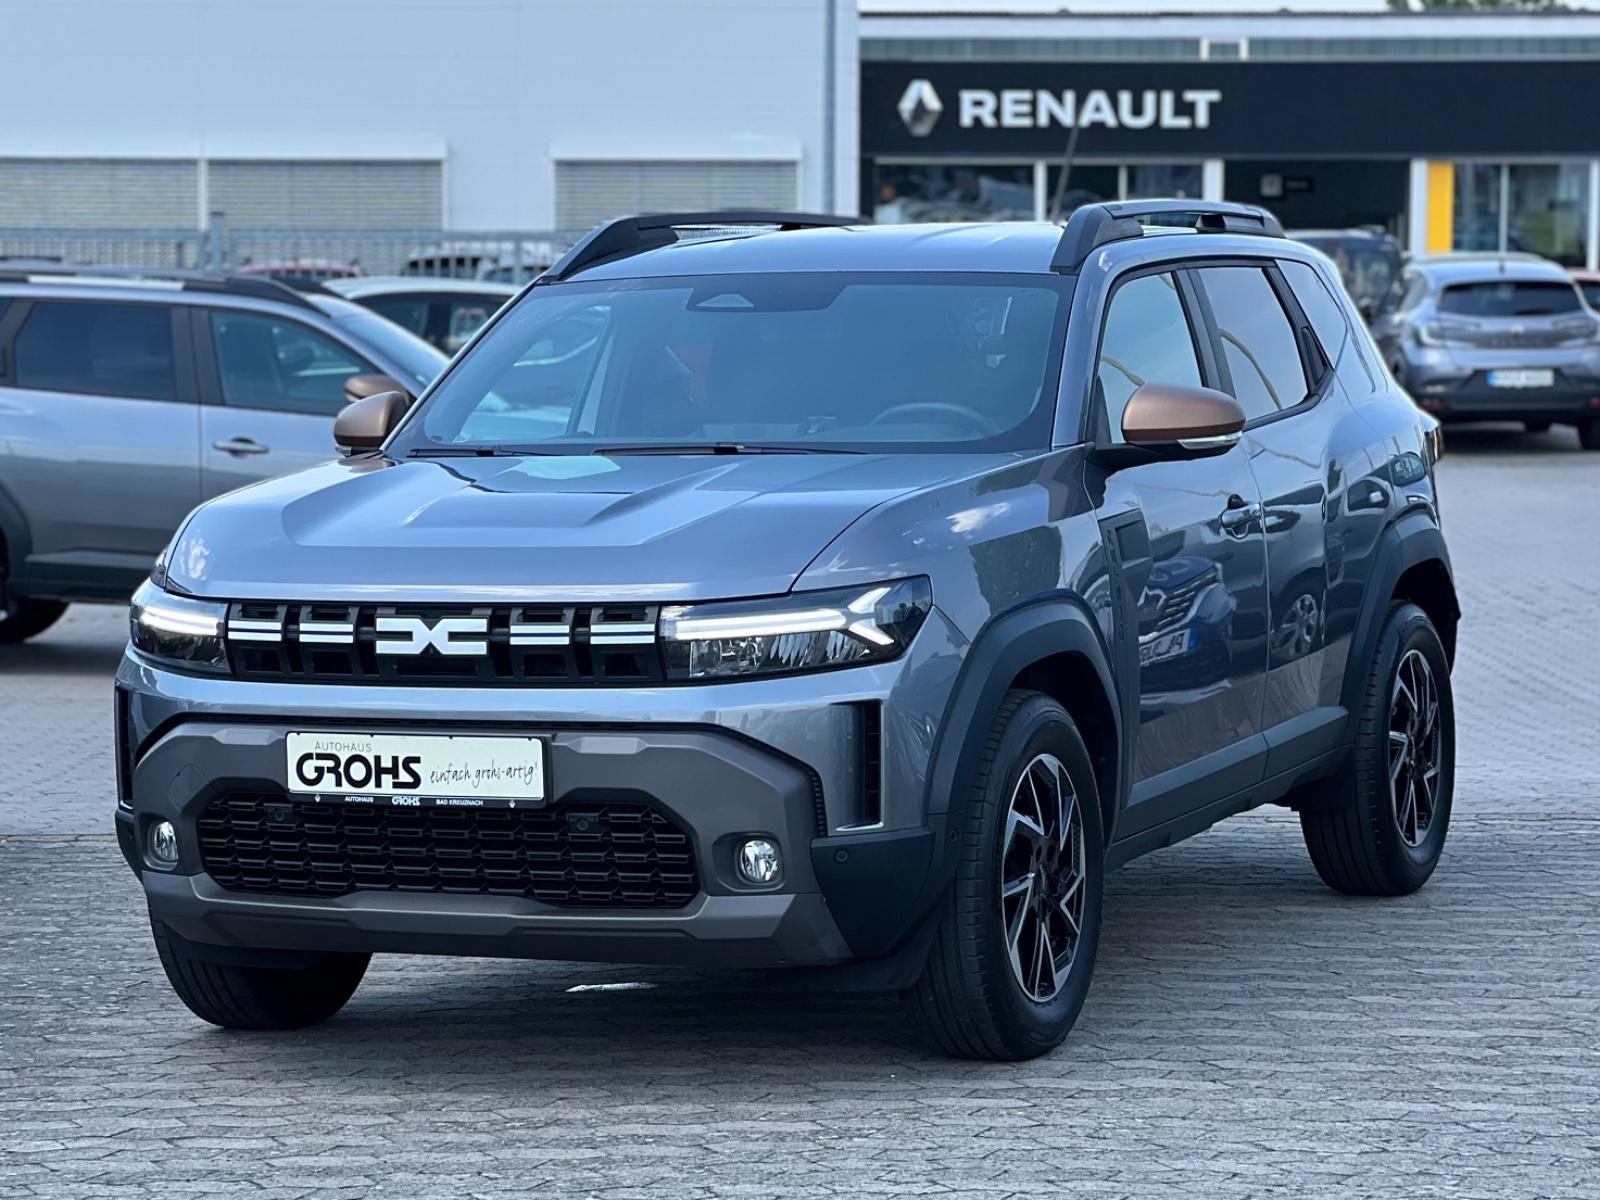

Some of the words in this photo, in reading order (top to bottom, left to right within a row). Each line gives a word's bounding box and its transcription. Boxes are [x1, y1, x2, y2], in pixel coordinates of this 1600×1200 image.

[959, 89, 1222, 129] RENAULT
[314, 741, 372, 753] AUTOHAUS
[296, 752, 422, 790] GROHS
[430, 762, 471, 784] einfach
[472, 758, 538, 788] grohs-artig!
[391, 796, 421, 806] GROHS
[448, 799, 484, 807] KREUZNACH
